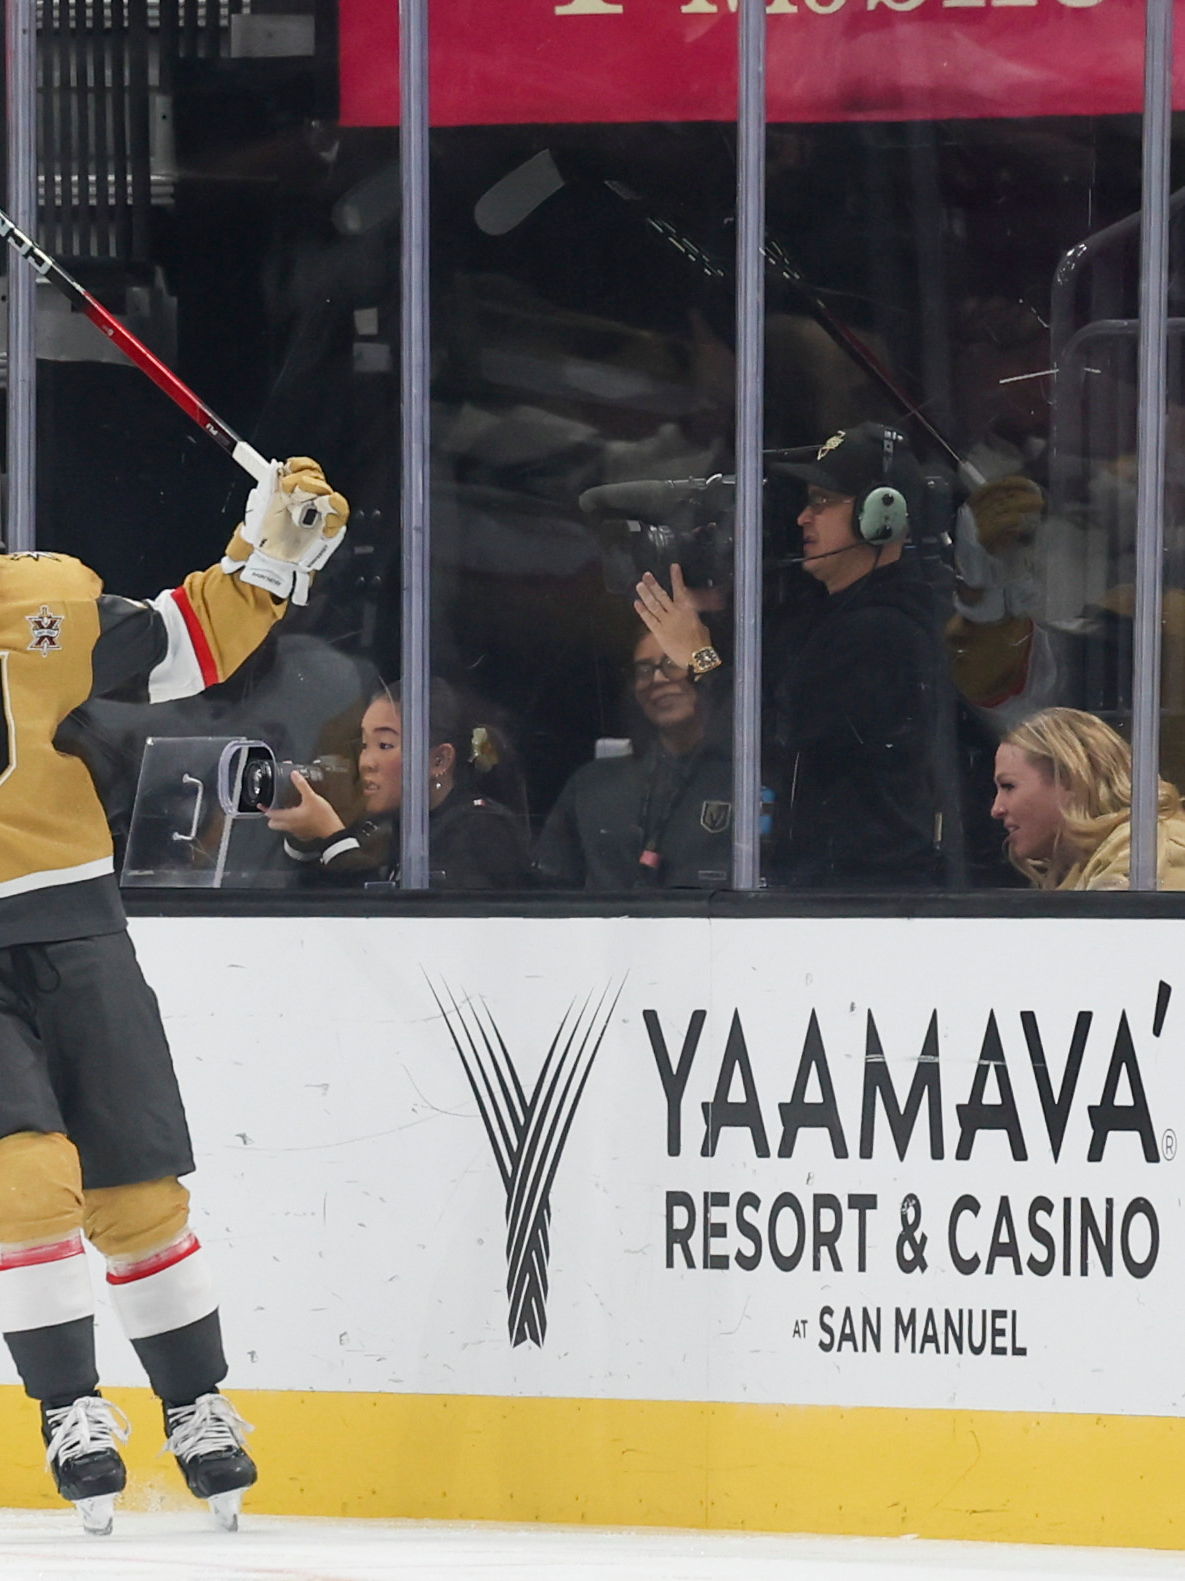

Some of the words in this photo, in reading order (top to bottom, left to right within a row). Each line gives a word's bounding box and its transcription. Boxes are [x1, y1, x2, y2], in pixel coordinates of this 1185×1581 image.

[642, 979, 1172, 1165] YAAMAVA'
[665, 1190, 878, 1273] RESORT
[895, 1192, 929, 1275] &
[947, 1193, 1160, 1280] CASINO
[792, 1319, 809, 1339] AT
[818, 1305, 882, 1353] SAN
[894, 1306, 1028, 1357] MANUEL
